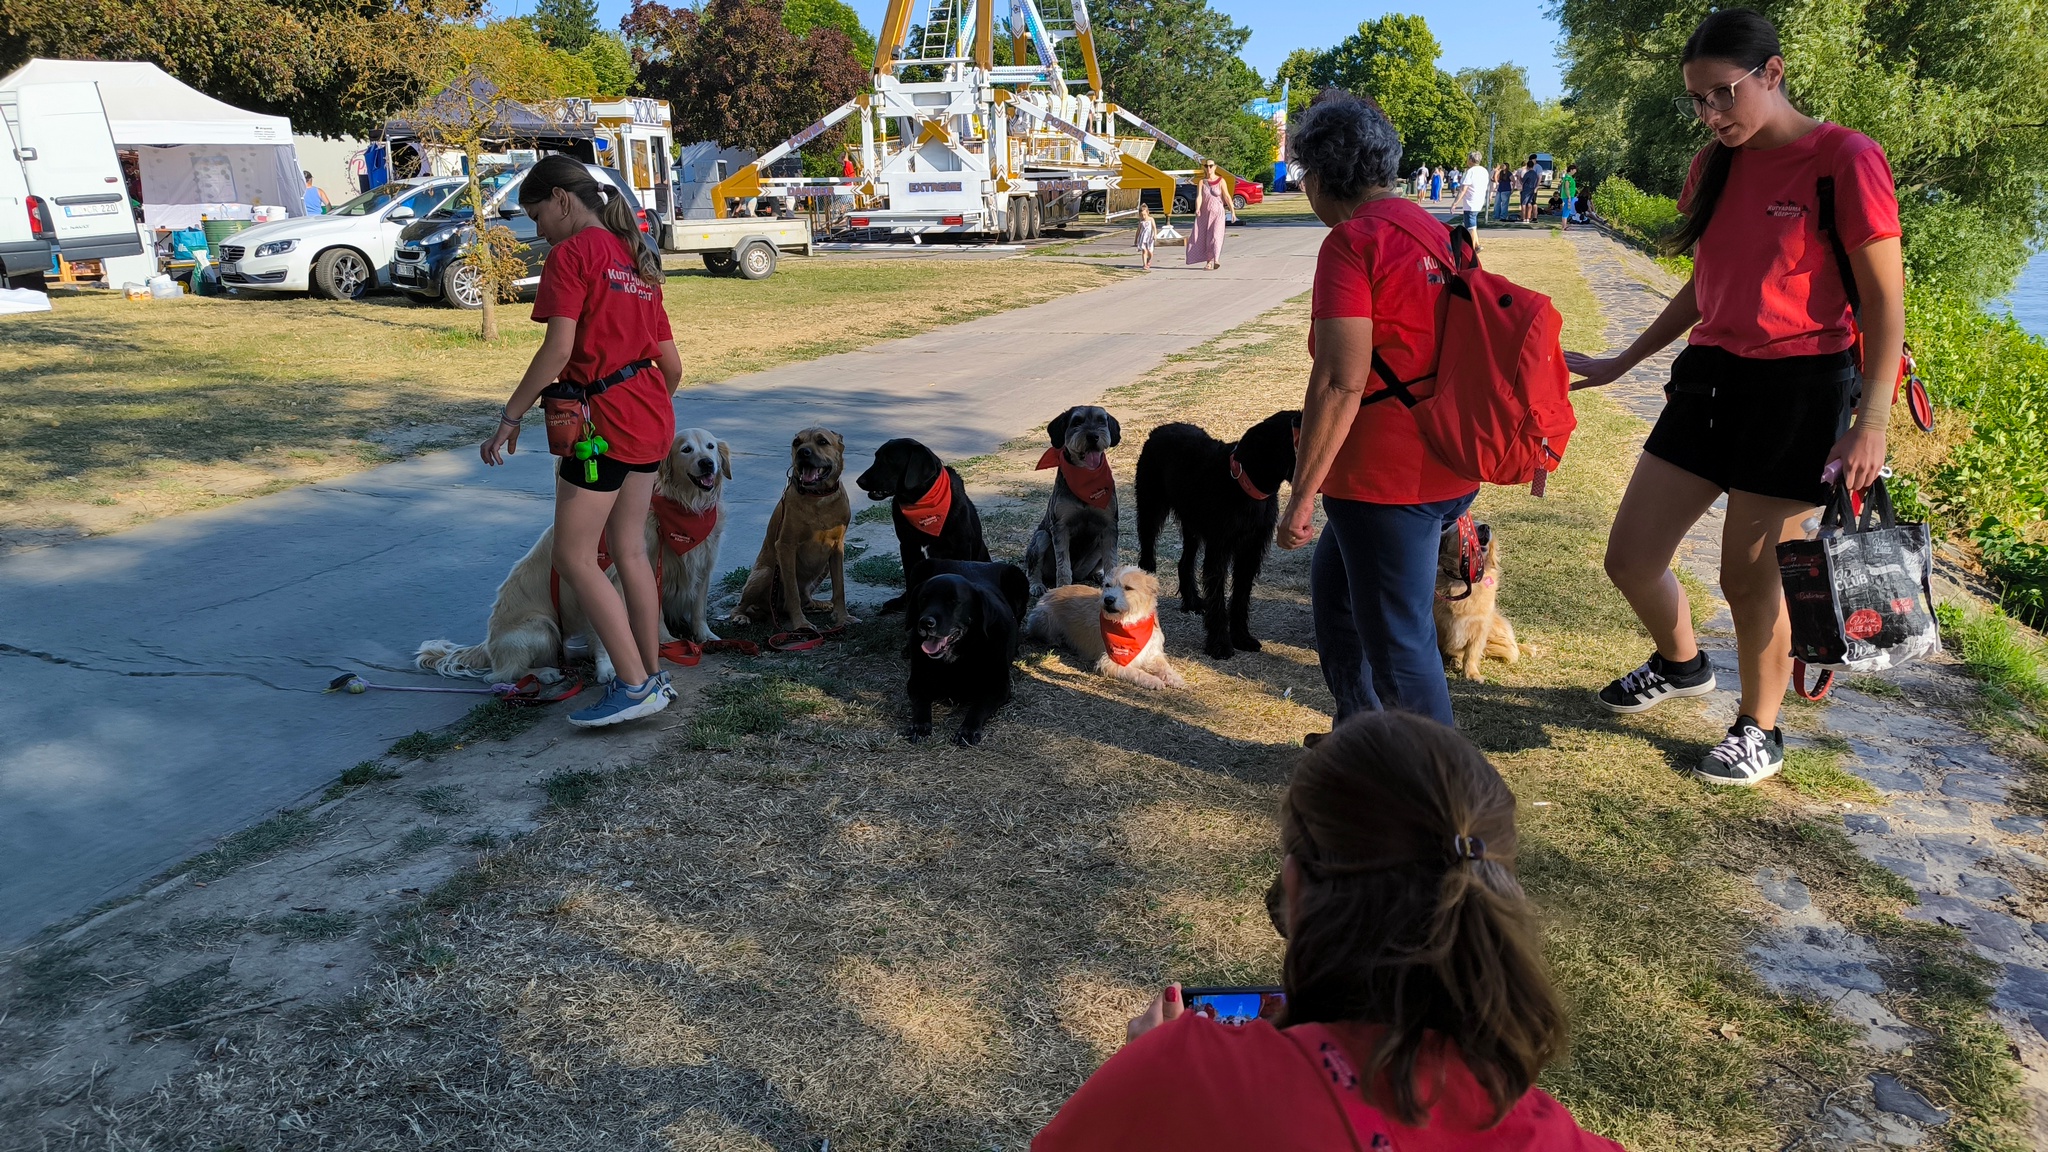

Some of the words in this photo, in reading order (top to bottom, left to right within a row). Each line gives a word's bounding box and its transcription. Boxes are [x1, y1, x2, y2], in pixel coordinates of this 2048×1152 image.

[632, 97, 663, 124] XXL
[787, 119, 827, 149] POWER
[1044, 113, 1087, 142] POWER
[786, 186, 835, 197] DANGER
[908, 181, 963, 193] EXTREME
[1036, 180, 1089, 192] DANGER
[1835, 574, 1868, 591] CLUB
